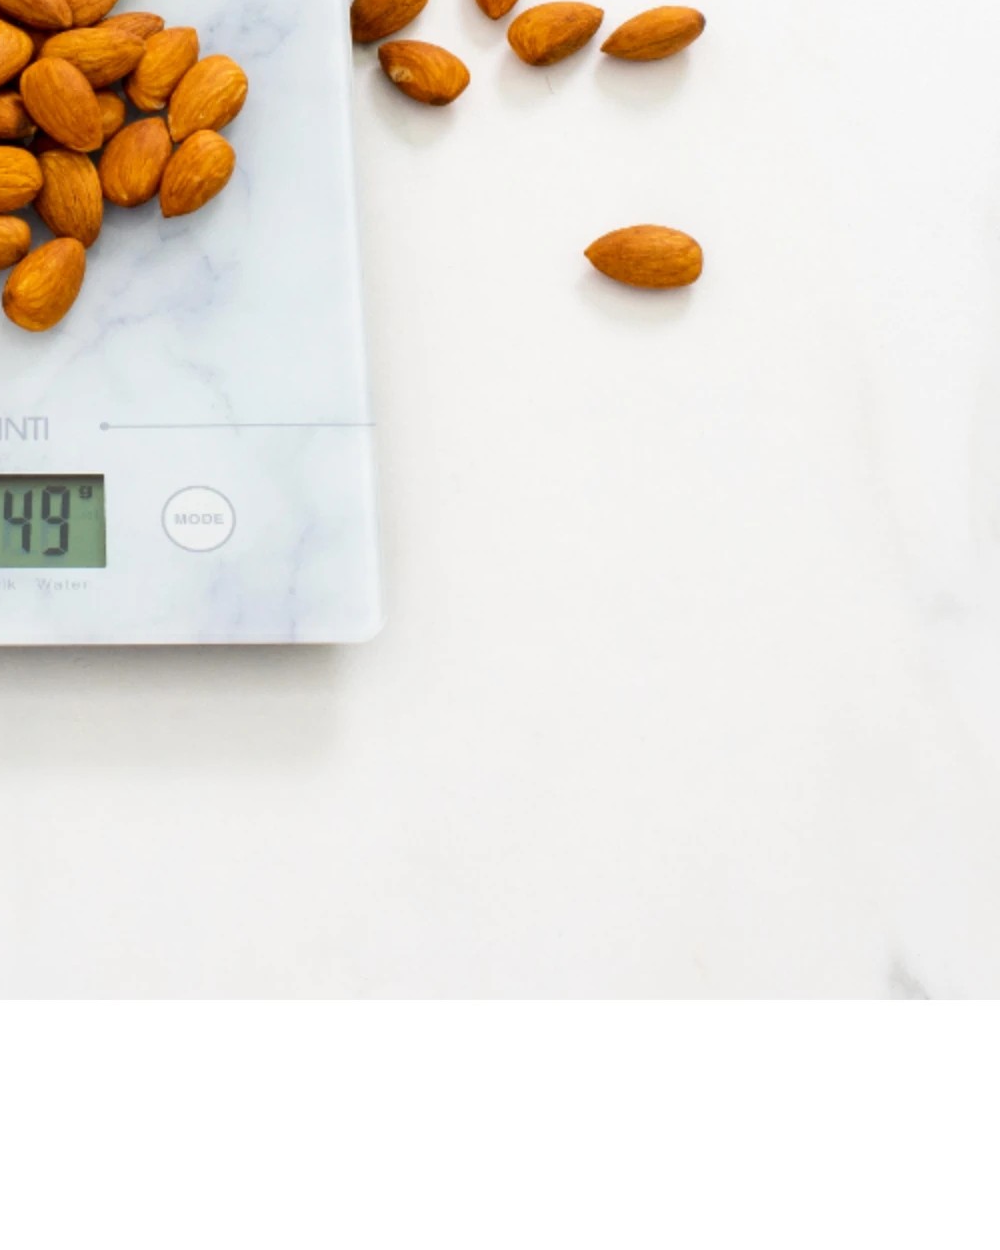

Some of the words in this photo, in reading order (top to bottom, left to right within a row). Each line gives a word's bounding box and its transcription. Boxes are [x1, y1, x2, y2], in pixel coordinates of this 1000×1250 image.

[3, 485, 71, 556] 49
[173, 513, 225, 525] MODE
[35, 578, 88, 591] Water
